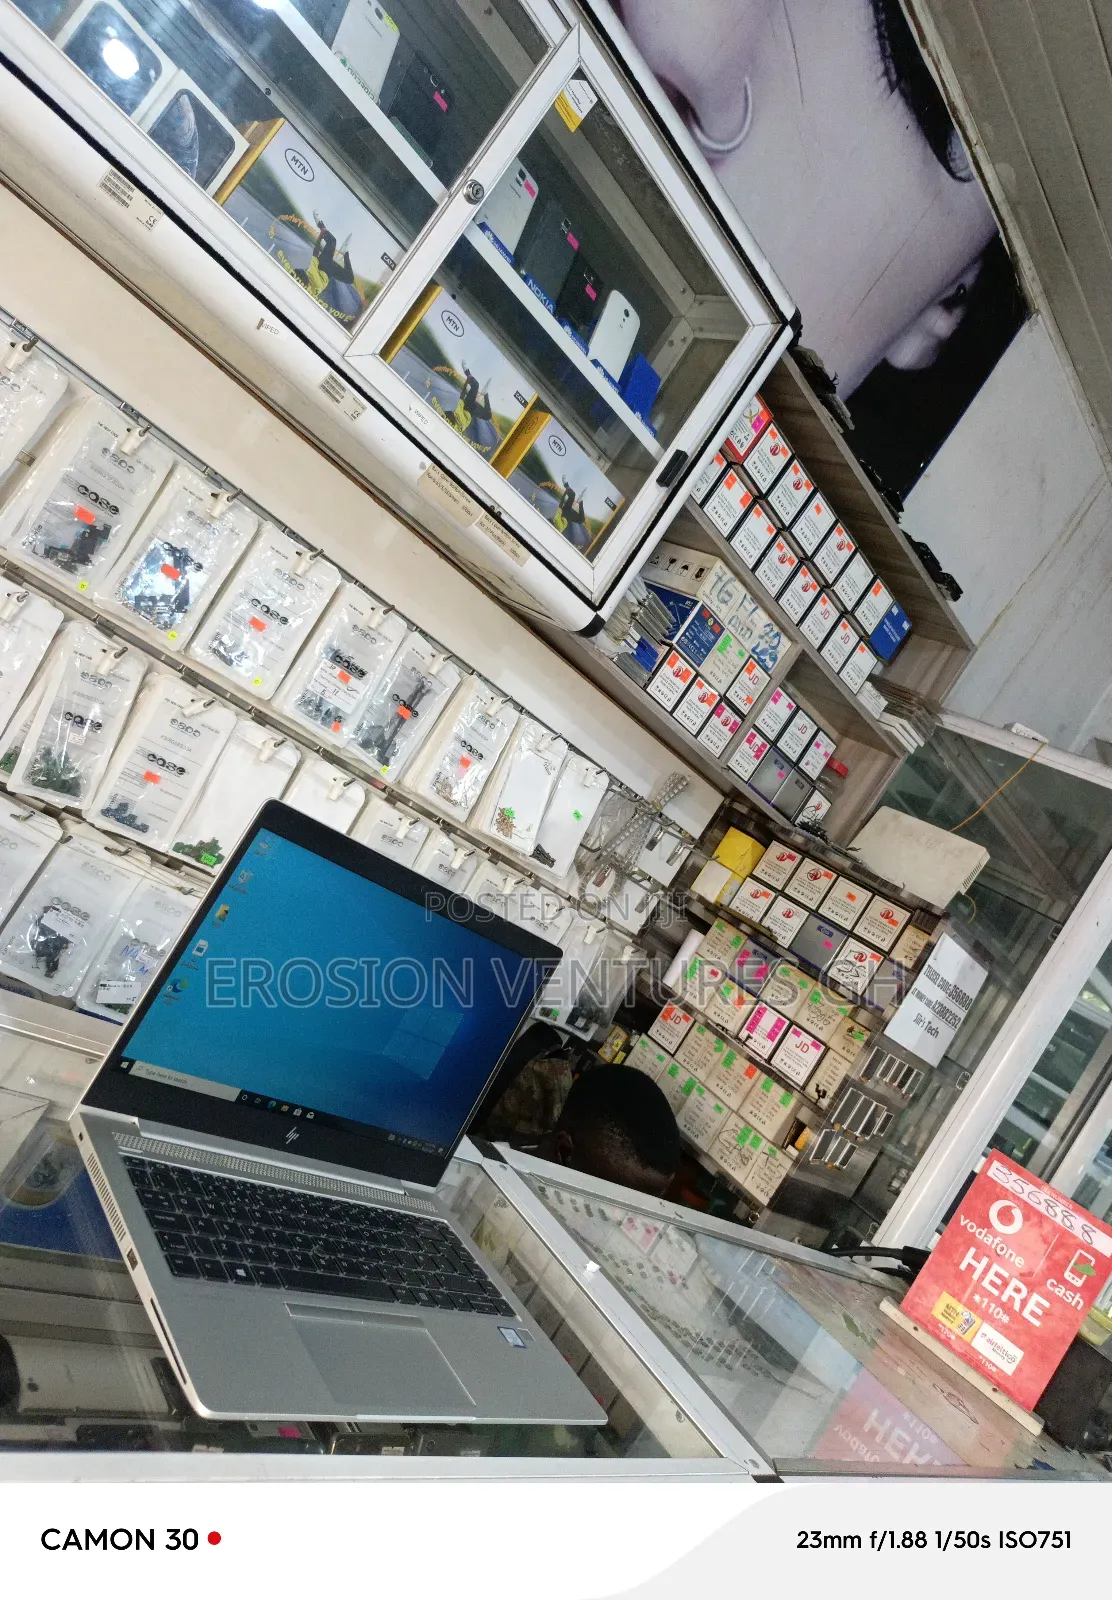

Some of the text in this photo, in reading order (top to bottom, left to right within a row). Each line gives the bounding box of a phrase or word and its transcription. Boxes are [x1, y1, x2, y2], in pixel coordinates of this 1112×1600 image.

[289, 153, 310, 177] MTN
[527, 278, 556, 314] NOKIA
[445, 315, 461, 334] MTN
[551, 438, 565, 455] MTN
[75, 482, 121, 516] case
[249, 596, 290, 626] case
[820, 609, 830, 620] JD
[840, 634, 850, 644] JD
[748, 674, 758, 686] JD
[63, 710, 103, 731] case
[798, 723, 807, 735] JD
[459, 739, 484, 760] case
[146, 751, 186, 776] case
[668, 1011, 682, 1025] JD
[924, 1021, 939, 1039] Tech
[795, 1038, 810, 1054] JD
[143, 1067, 157, 1078] Type
[157, 1071, 167, 1079] here
[172, 1076, 188, 1085] search
[992, 1164, 1097, 1246] 356888
[958, 1214, 1026, 1269] vodafone
[959, 1246, 1051, 1328] HERE
[1046, 1276, 1085, 1311] cash
[986, 1337, 1018, 1363] airteltigo
